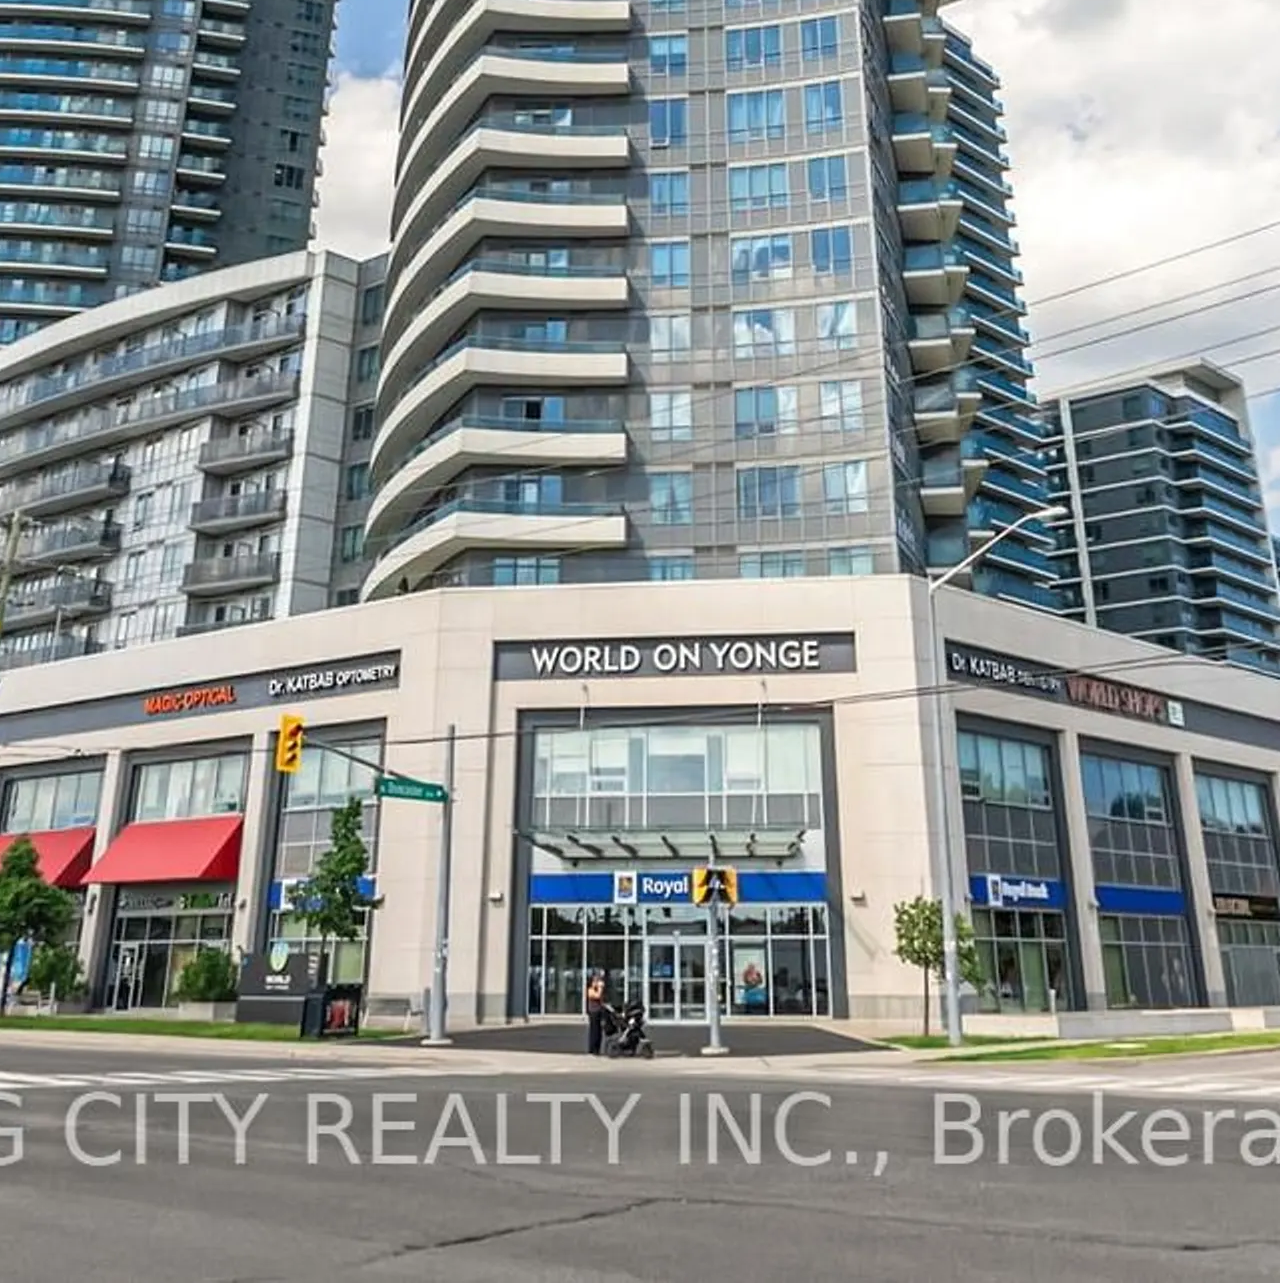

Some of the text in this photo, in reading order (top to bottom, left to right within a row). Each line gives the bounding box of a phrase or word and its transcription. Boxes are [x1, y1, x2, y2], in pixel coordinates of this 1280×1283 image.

[531, 640, 820, 673] WORLD ON YONGE
[969, 655, 1016, 684] KATBAB
[286, 670, 334, 693] KATBAB
[335, 664, 396, 686] OPTOMETRY
[642, 875, 690, 899] Royal
